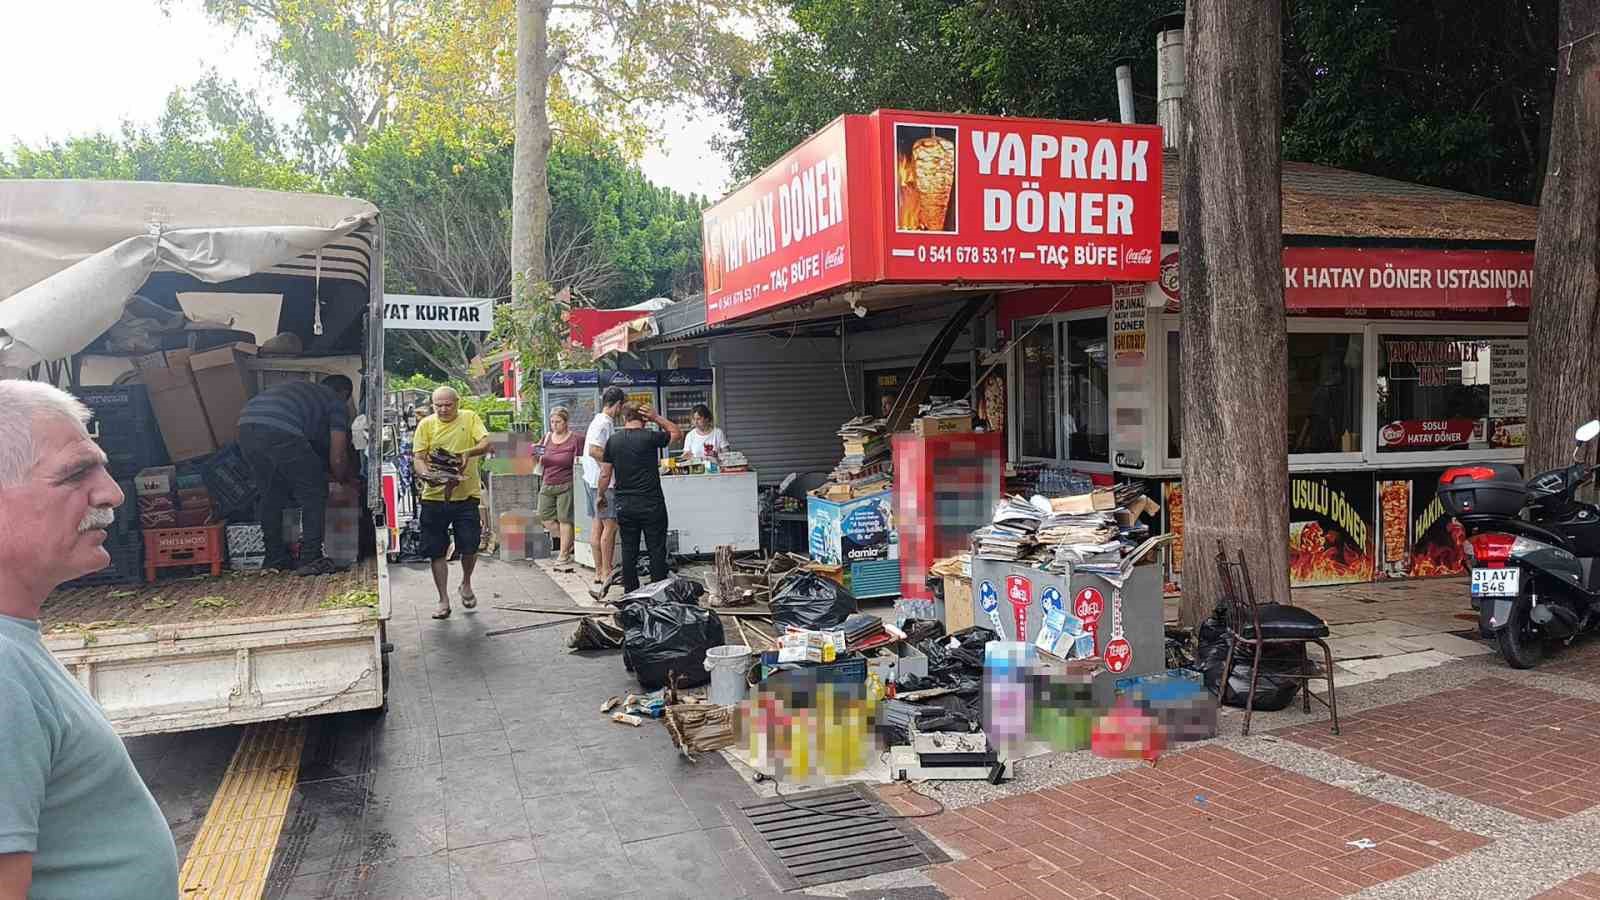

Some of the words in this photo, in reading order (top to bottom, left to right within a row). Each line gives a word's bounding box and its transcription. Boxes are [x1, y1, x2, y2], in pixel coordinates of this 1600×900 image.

[972, 131, 1149, 181] YAPRAK
[721, 191, 776, 272] YAPRAK
[779, 158, 843, 248] DÖNER
[984, 182, 1134, 235] DÖNER
[918, 246, 926, 262] 0
[929, 246, 951, 263] 541
[956, 247, 978, 263] 678
[982, 247, 997, 264] 53
[1001, 248, 1015, 264] 17
[1037, 245, 1069, 268] TAÇ
[1075, 243, 1117, 265] BÜFE
[770, 267, 788, 292] TAÇ
[791, 253, 819, 284] BÜFE
[1284, 267, 1299, 289] K
[1303, 267, 1364, 289] HATAY
[1369, 262, 1432, 289] DÖNER
[416, 305, 480, 322] KURTAR
[1385, 341, 1434, 363] YAPRAK
[1408, 433, 1432, 443] HATAY
[1435, 431, 1461, 442] DÖNER
[1292, 479, 1329, 515] USULÜ
[1331, 489, 1367, 555] DÖNER
[1415, 491, 1447, 544] HAKİK
[848, 548, 878, 558] damla
[1474, 571, 1487, 581] 31
[1492, 570, 1516, 580] AVT
[1482, 582, 1505, 592] 546
